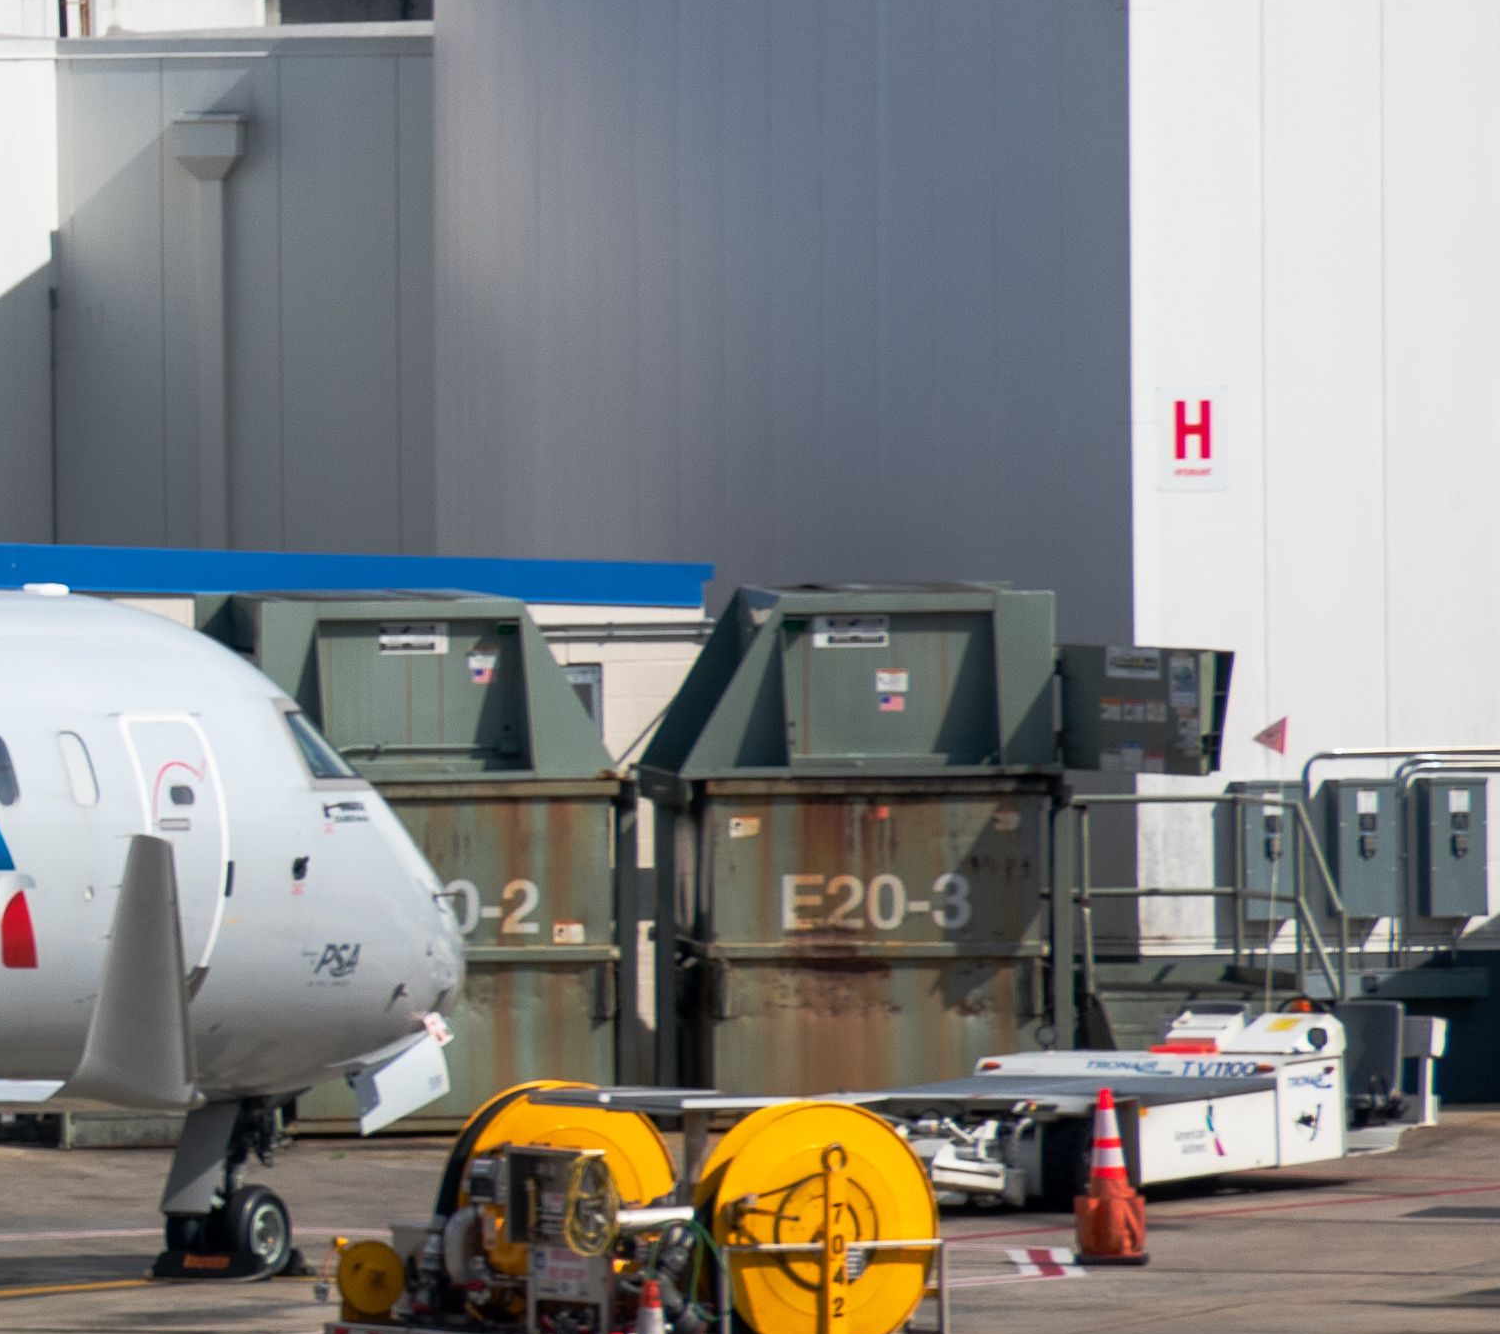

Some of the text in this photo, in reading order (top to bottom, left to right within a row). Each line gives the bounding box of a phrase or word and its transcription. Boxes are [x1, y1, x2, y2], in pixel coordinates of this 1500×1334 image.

[1173, 399, 1212, 460] H
[444, 879, 541, 935] 0-2
[781, 873, 973, 930] E20-3
[314, 943, 362, 978] PSA
[1182, 1060, 1258, 1077] TV1100
